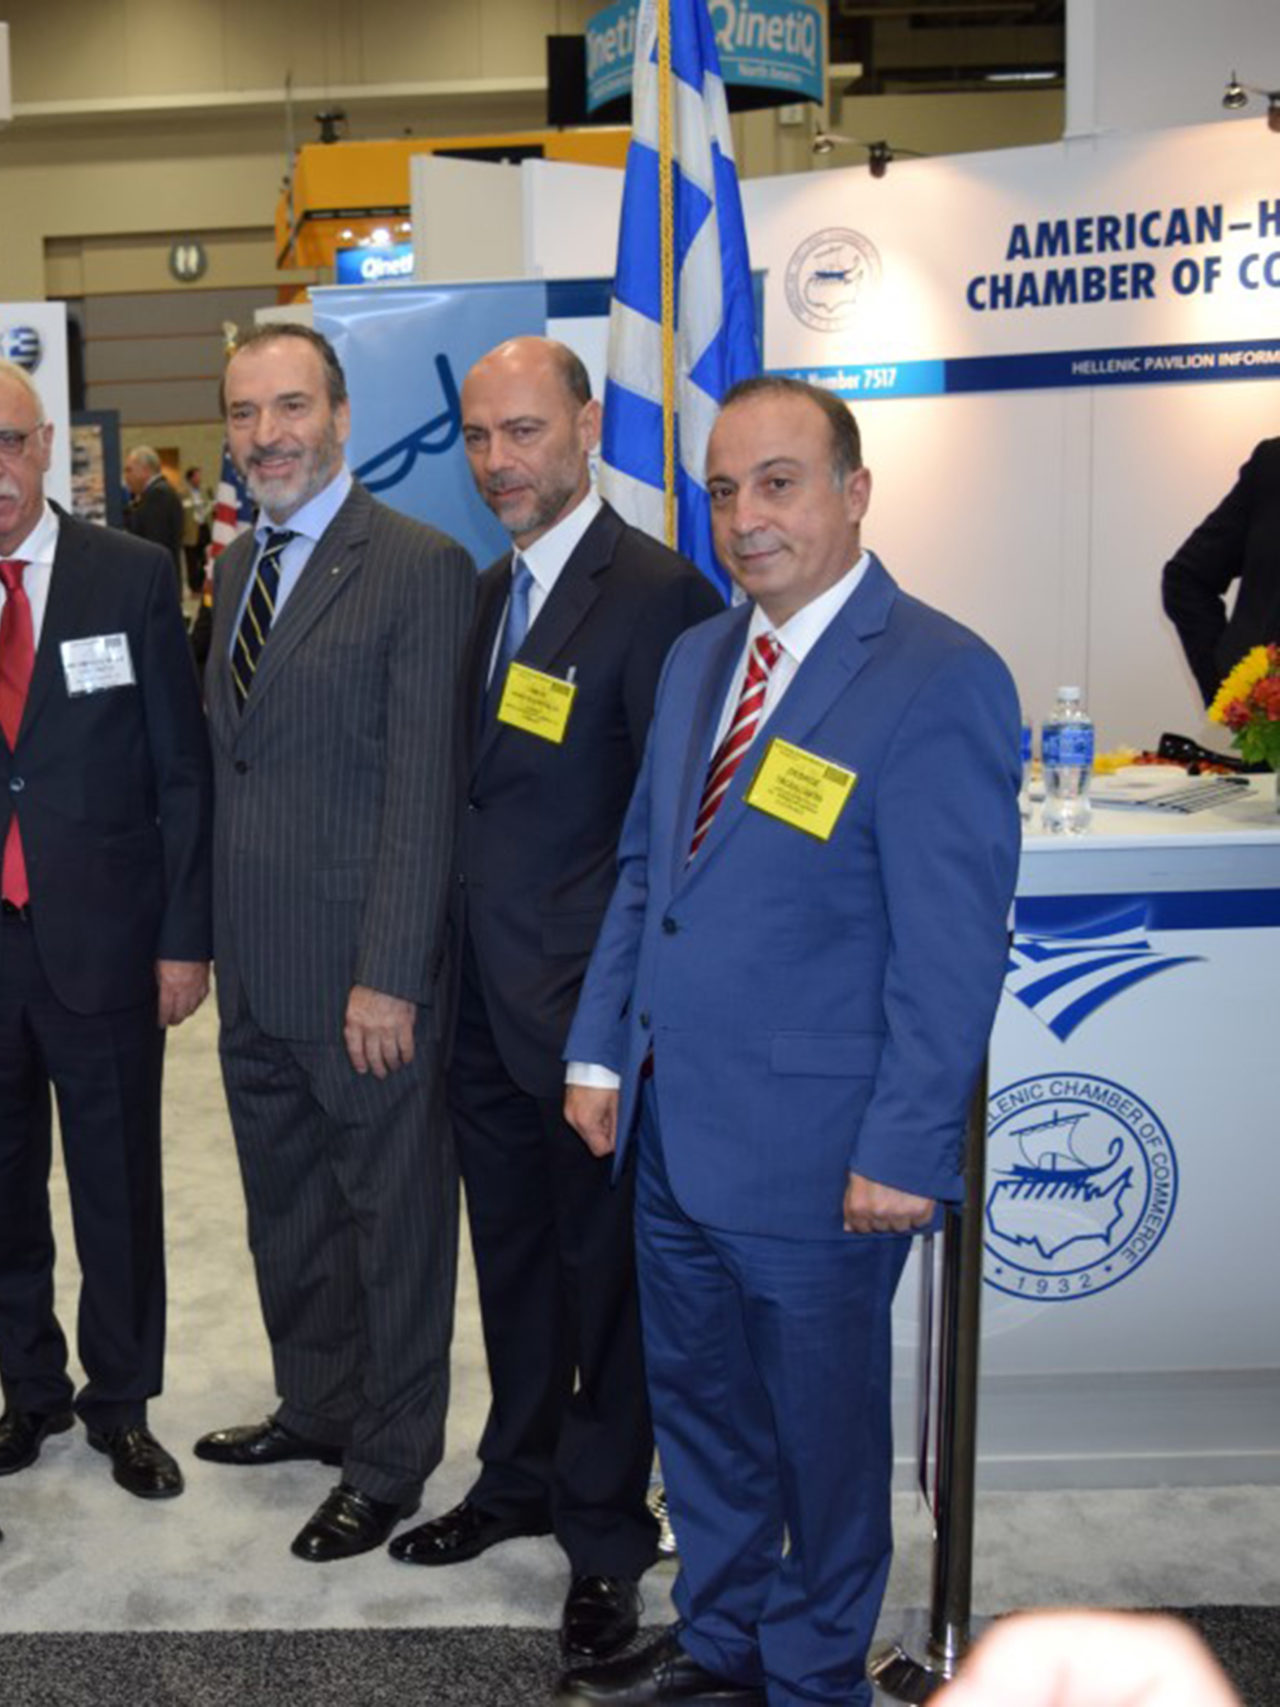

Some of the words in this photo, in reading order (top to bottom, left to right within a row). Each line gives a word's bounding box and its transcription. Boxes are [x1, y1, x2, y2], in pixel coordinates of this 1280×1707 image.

[966, 262, 1156, 311] CHAMBER
[1172, 256, 1222, 295] OF
[863, 367, 897, 390] 7517
[1071, 357, 1141, 376] HELLENIC
[1144, 353, 1214, 372] PAVILION
[1049, 1080, 1142, 1126] CHAMBER
[1138, 1122, 1163, 1150] OF
[1121, 1152, 1170, 1264] COMMERCE
[1018, 1273, 1092, 1294] 1932
